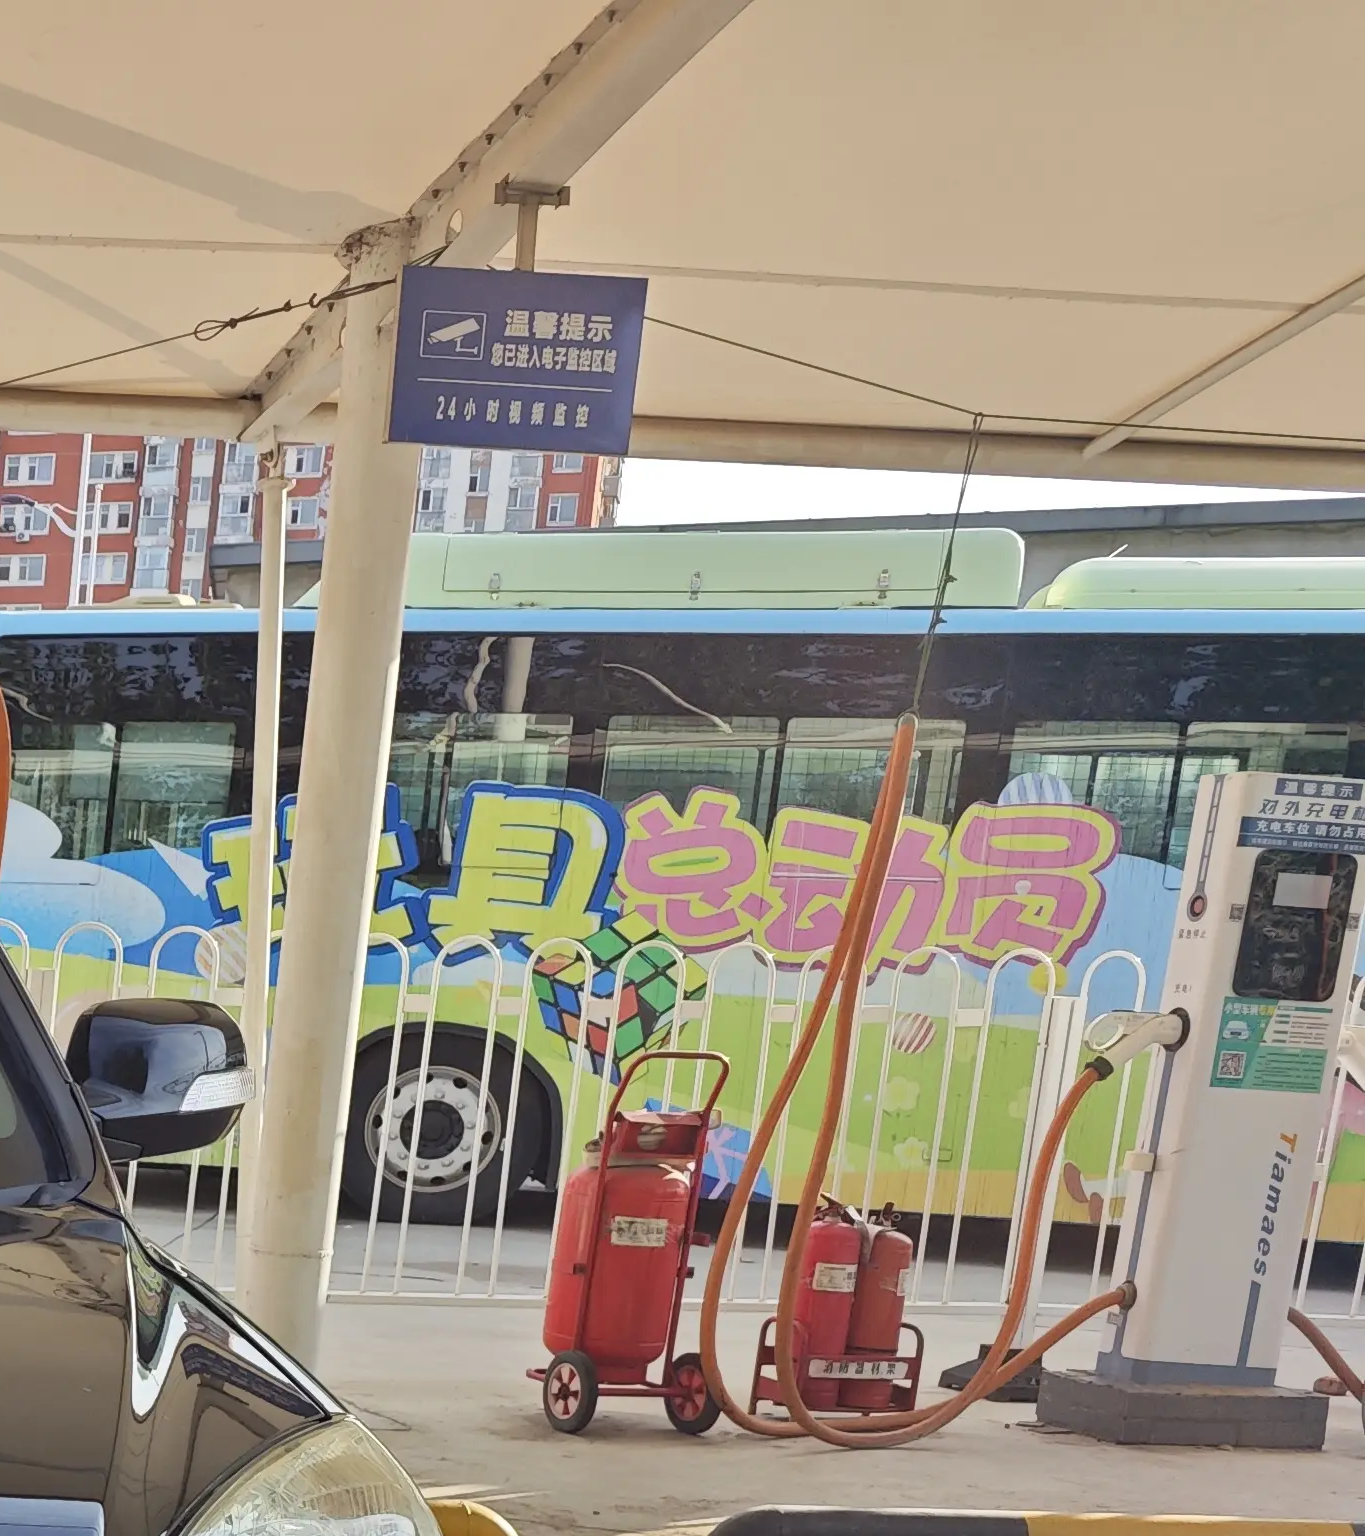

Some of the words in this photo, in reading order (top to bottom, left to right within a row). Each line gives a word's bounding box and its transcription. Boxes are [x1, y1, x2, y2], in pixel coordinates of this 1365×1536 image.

[504, 308, 614, 343] 温馨提示
[490, 342, 618, 374] 您已进入电子监控区域
[435, 395, 590, 429] 24小时视频监控
[1255, 820, 1310, 835] 充电车位
[1252, 1132, 1299, 1277] Tiamaes
